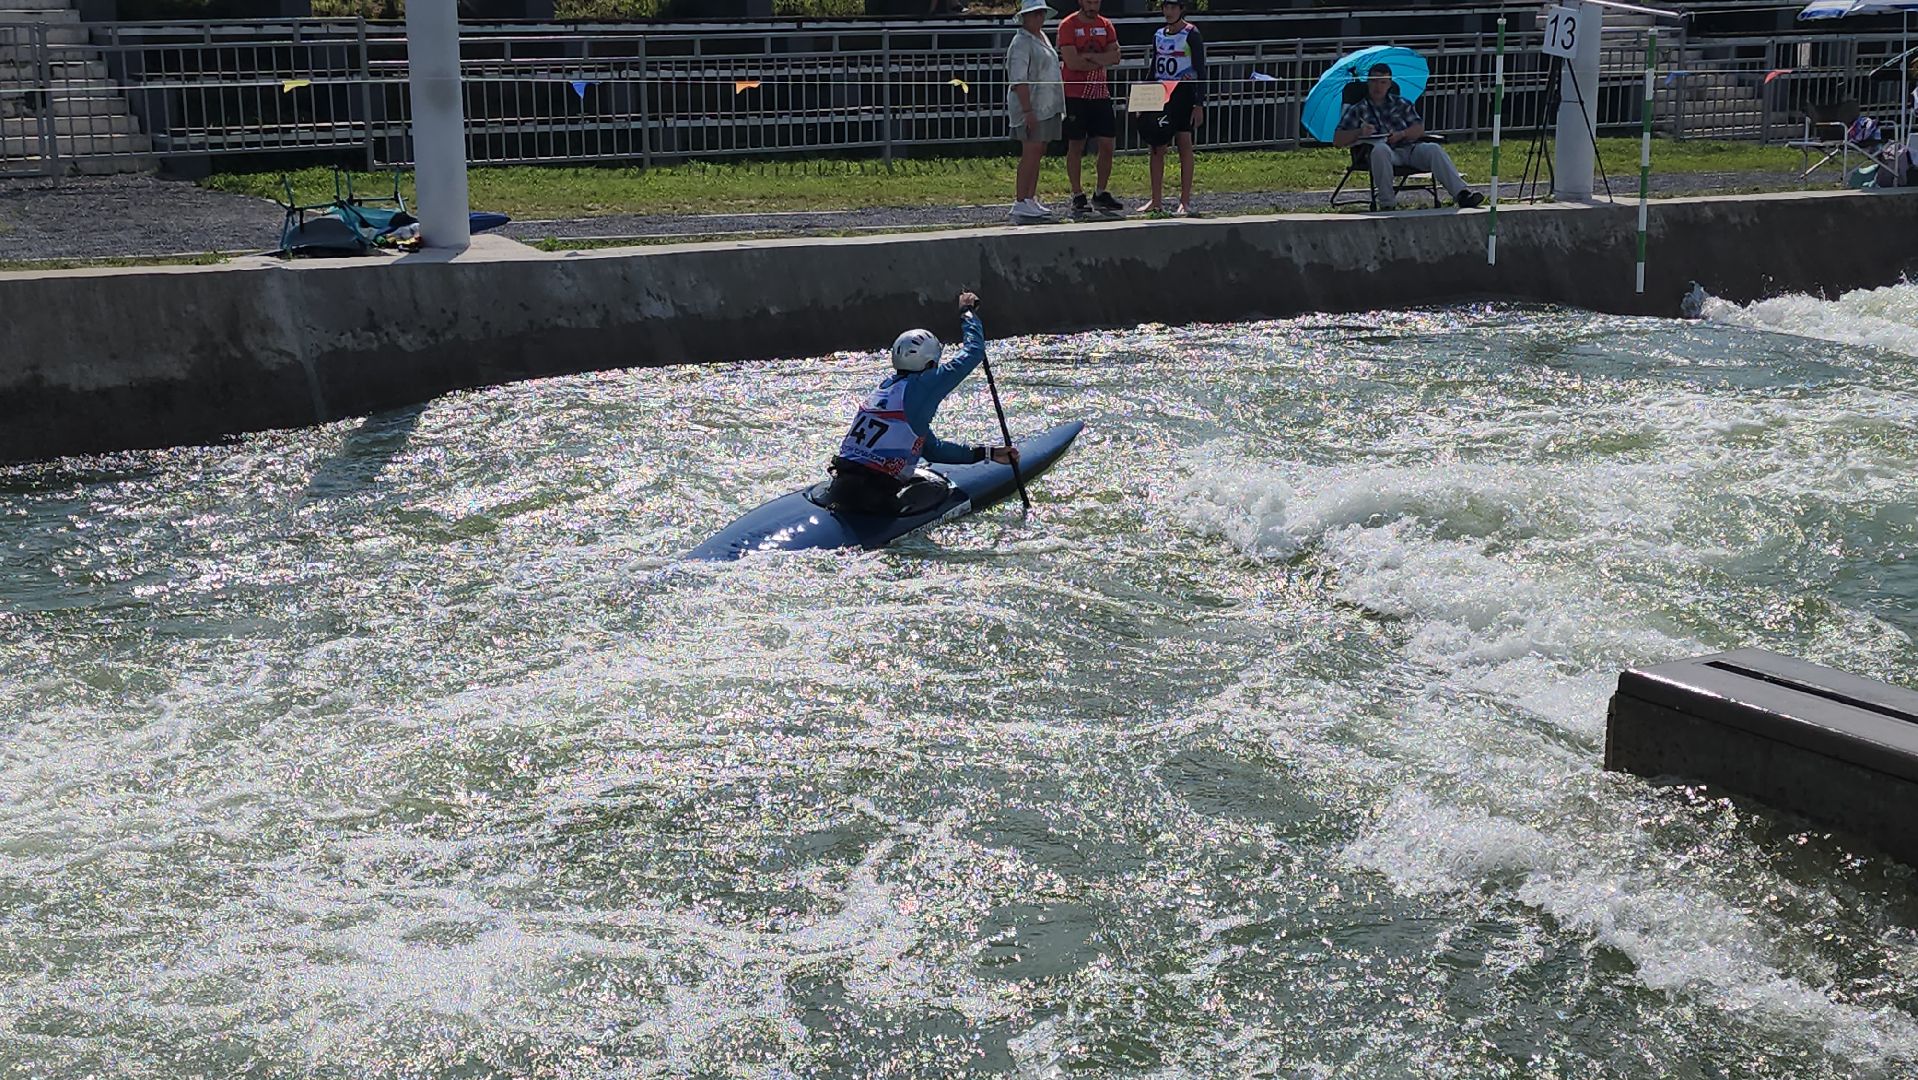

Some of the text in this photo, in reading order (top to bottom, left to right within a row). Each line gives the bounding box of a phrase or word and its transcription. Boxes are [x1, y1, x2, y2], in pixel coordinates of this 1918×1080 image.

[1549, 14, 1576, 50] 13
[1156, 57, 1178, 76] 60
[850, 415, 889, 449] 47
